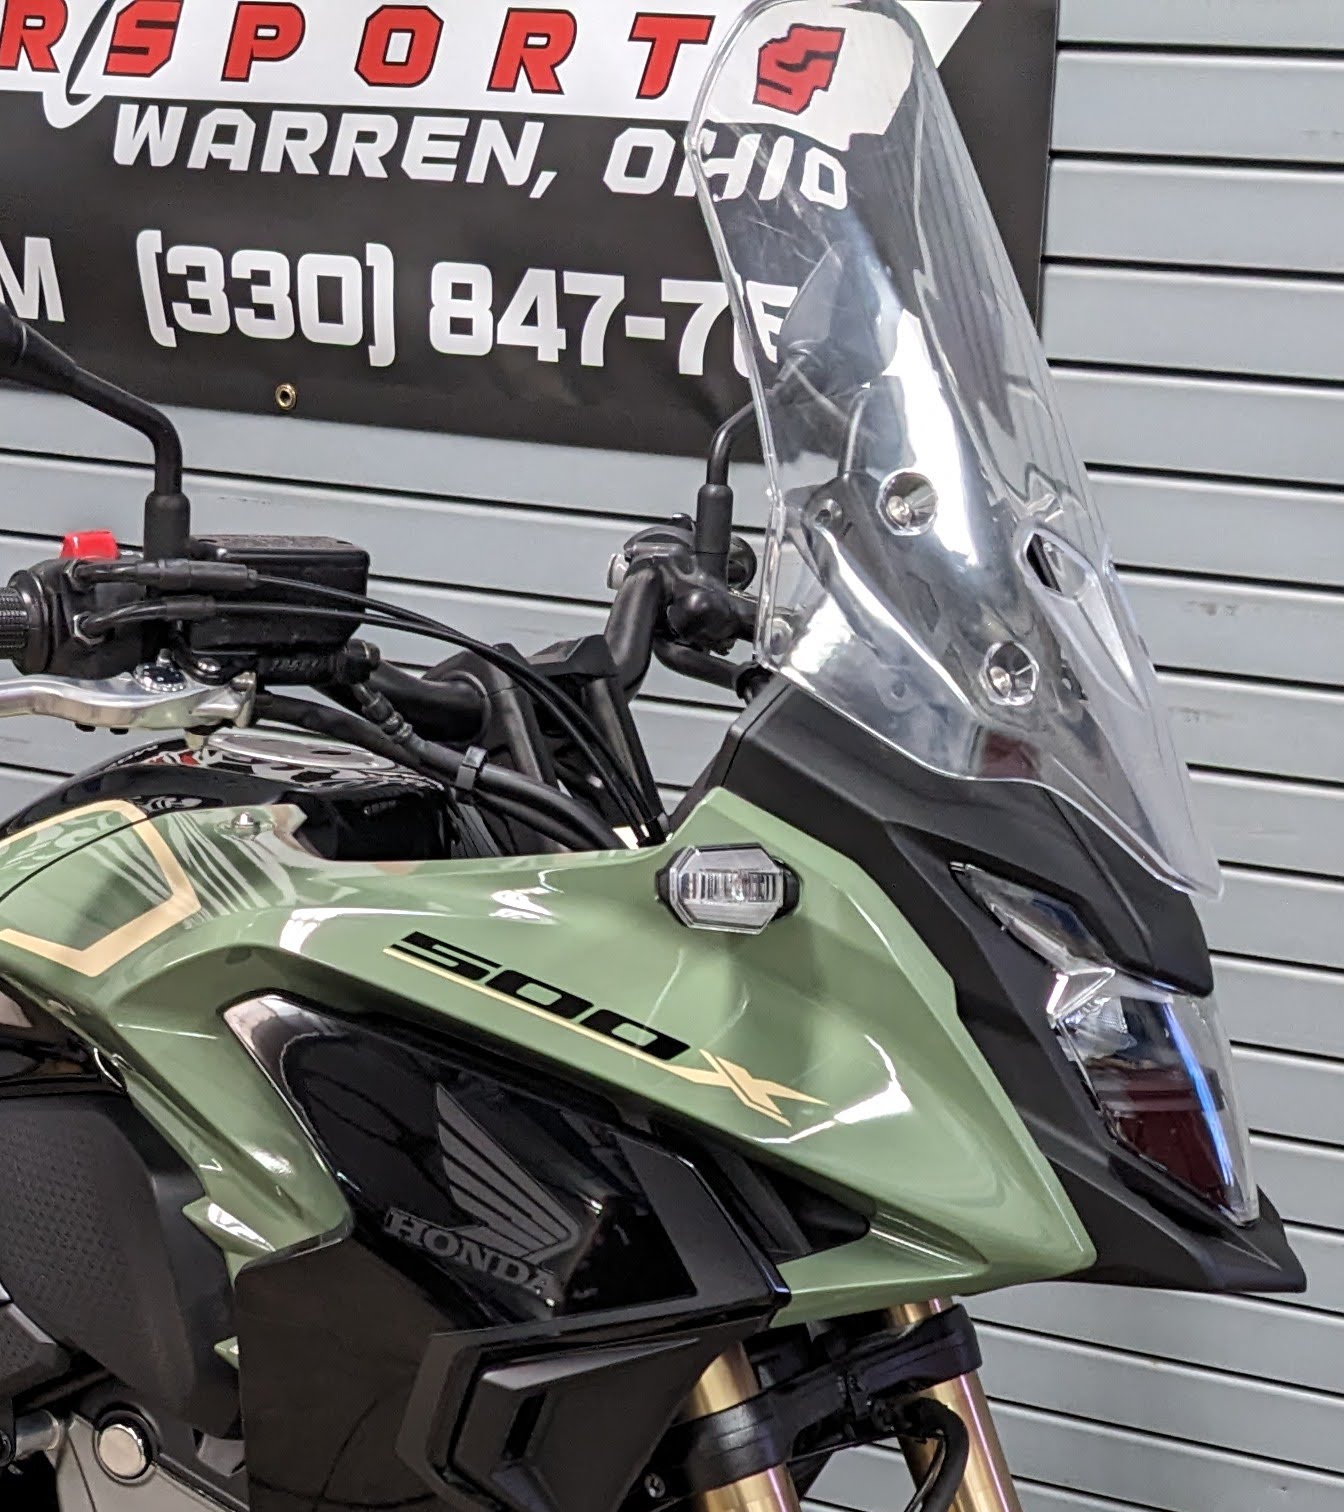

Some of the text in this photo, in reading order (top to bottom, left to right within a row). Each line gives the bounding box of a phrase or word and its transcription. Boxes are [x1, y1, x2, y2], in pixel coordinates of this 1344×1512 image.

[113, 104, 849, 210] WARREN, OHIO
[136, 229, 394, 367] (330)
[384, 1206, 562, 1305] HONDA
